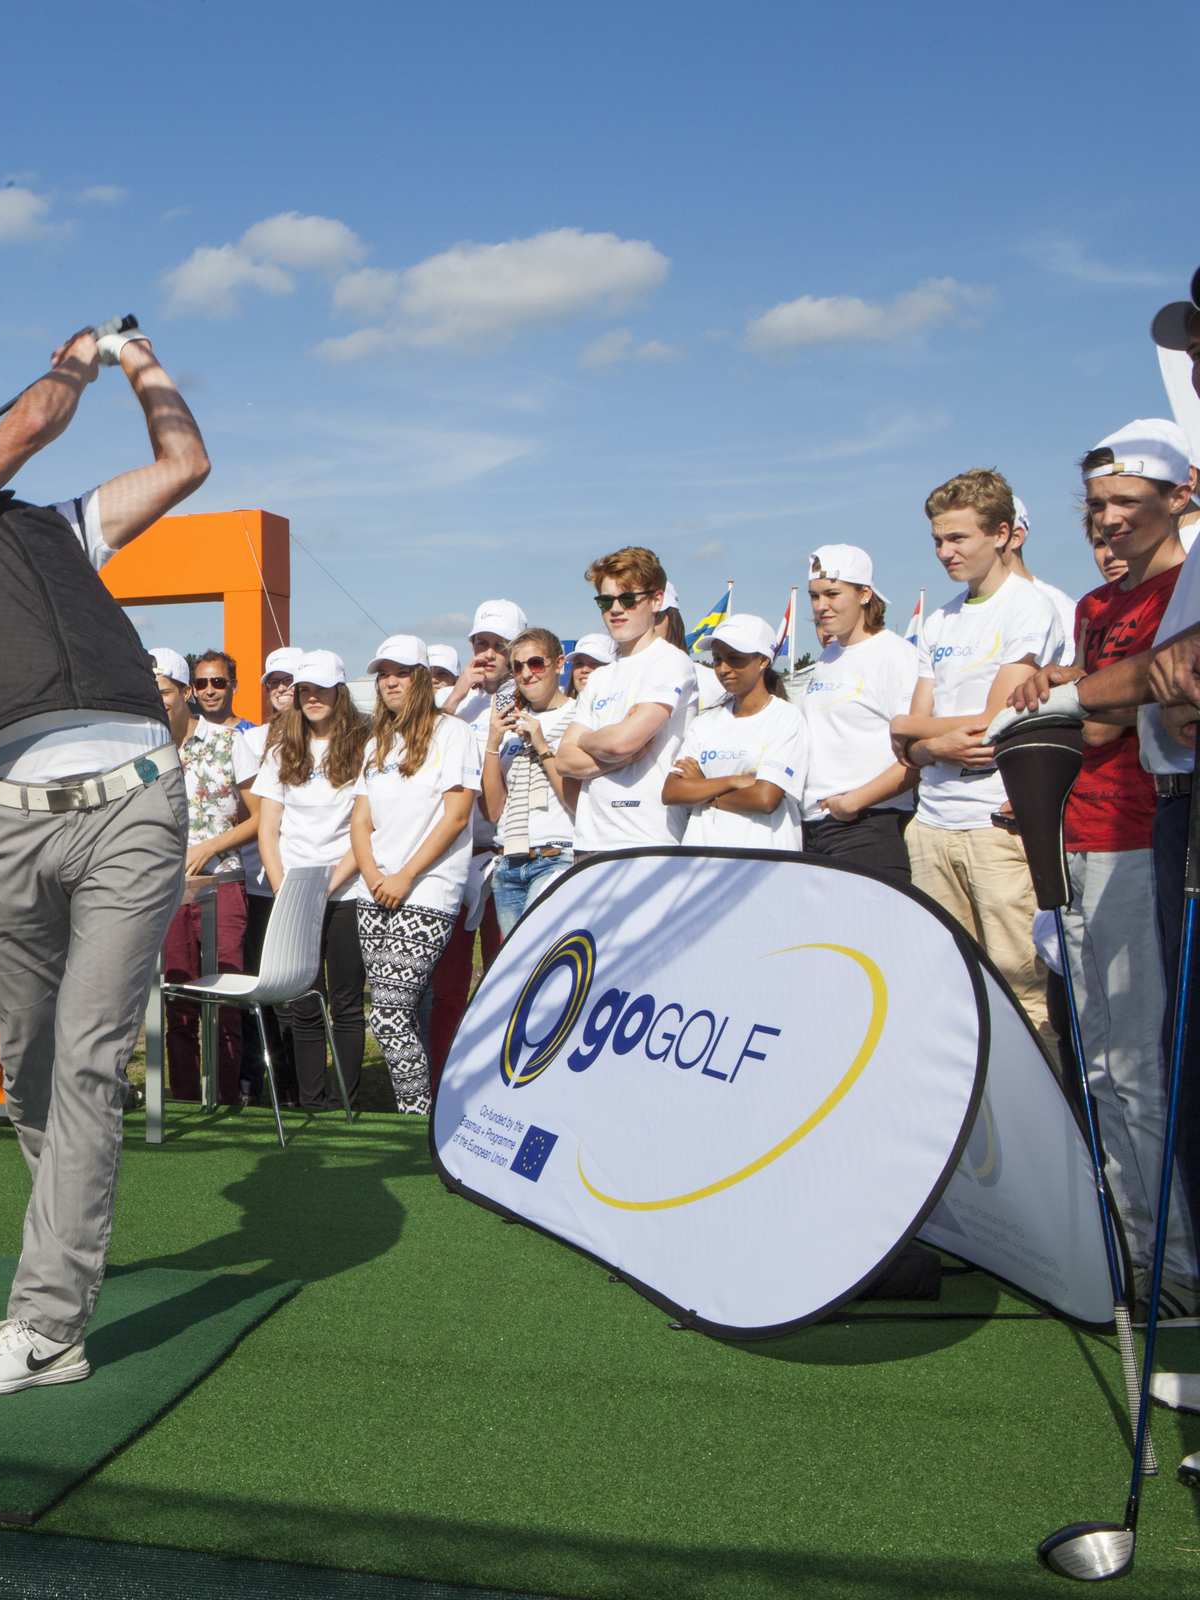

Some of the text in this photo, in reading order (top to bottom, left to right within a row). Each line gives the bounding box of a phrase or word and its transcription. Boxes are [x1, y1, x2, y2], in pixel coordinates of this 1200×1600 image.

[934, 642, 980, 662] goGOL
[700, 750, 748, 764] goGOLF
[567, 987, 782, 1084] goGOLF
[480, 1104, 508, 1126] Co-funded
[459, 1114, 482, 1134] Erasmus
[484, 1128, 516, 1150] Programme
[466, 1139, 492, 1160] European
[490, 1151, 508, 1168] Union
